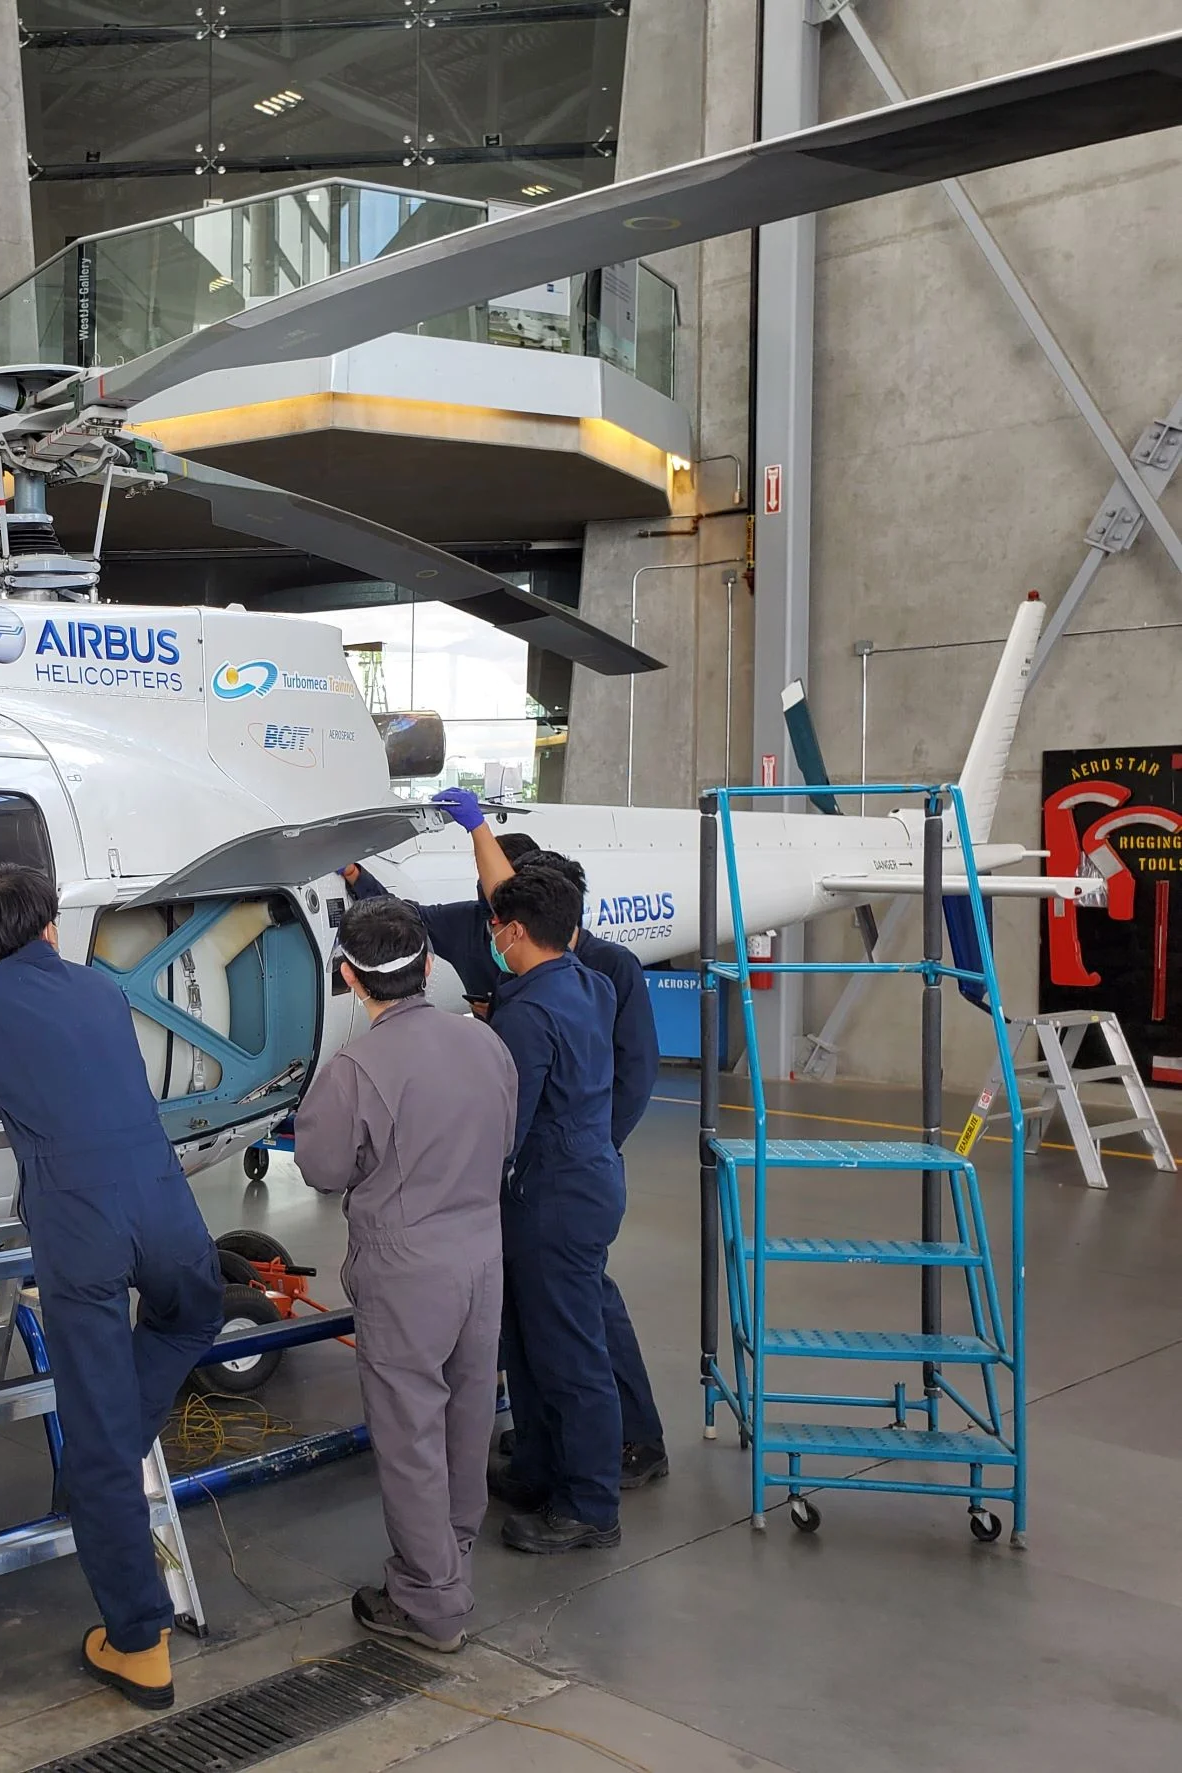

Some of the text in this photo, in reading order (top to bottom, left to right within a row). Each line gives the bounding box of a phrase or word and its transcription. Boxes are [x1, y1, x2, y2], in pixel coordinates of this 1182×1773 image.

[79, 257, 92, 341] WestJet Gallery
[35, 619, 180, 666] AIRBUS
[35, 663, 182, 692] HELICOPTERS
[282, 673, 355, 698] Turbomeca Training
[328, 729, 355, 741] AEROSPACE
[1071, 757, 1160, 780] AEROSTAR
[1119, 835, 1182, 849] RIGGING
[597, 892, 675, 926] AIRBUS
